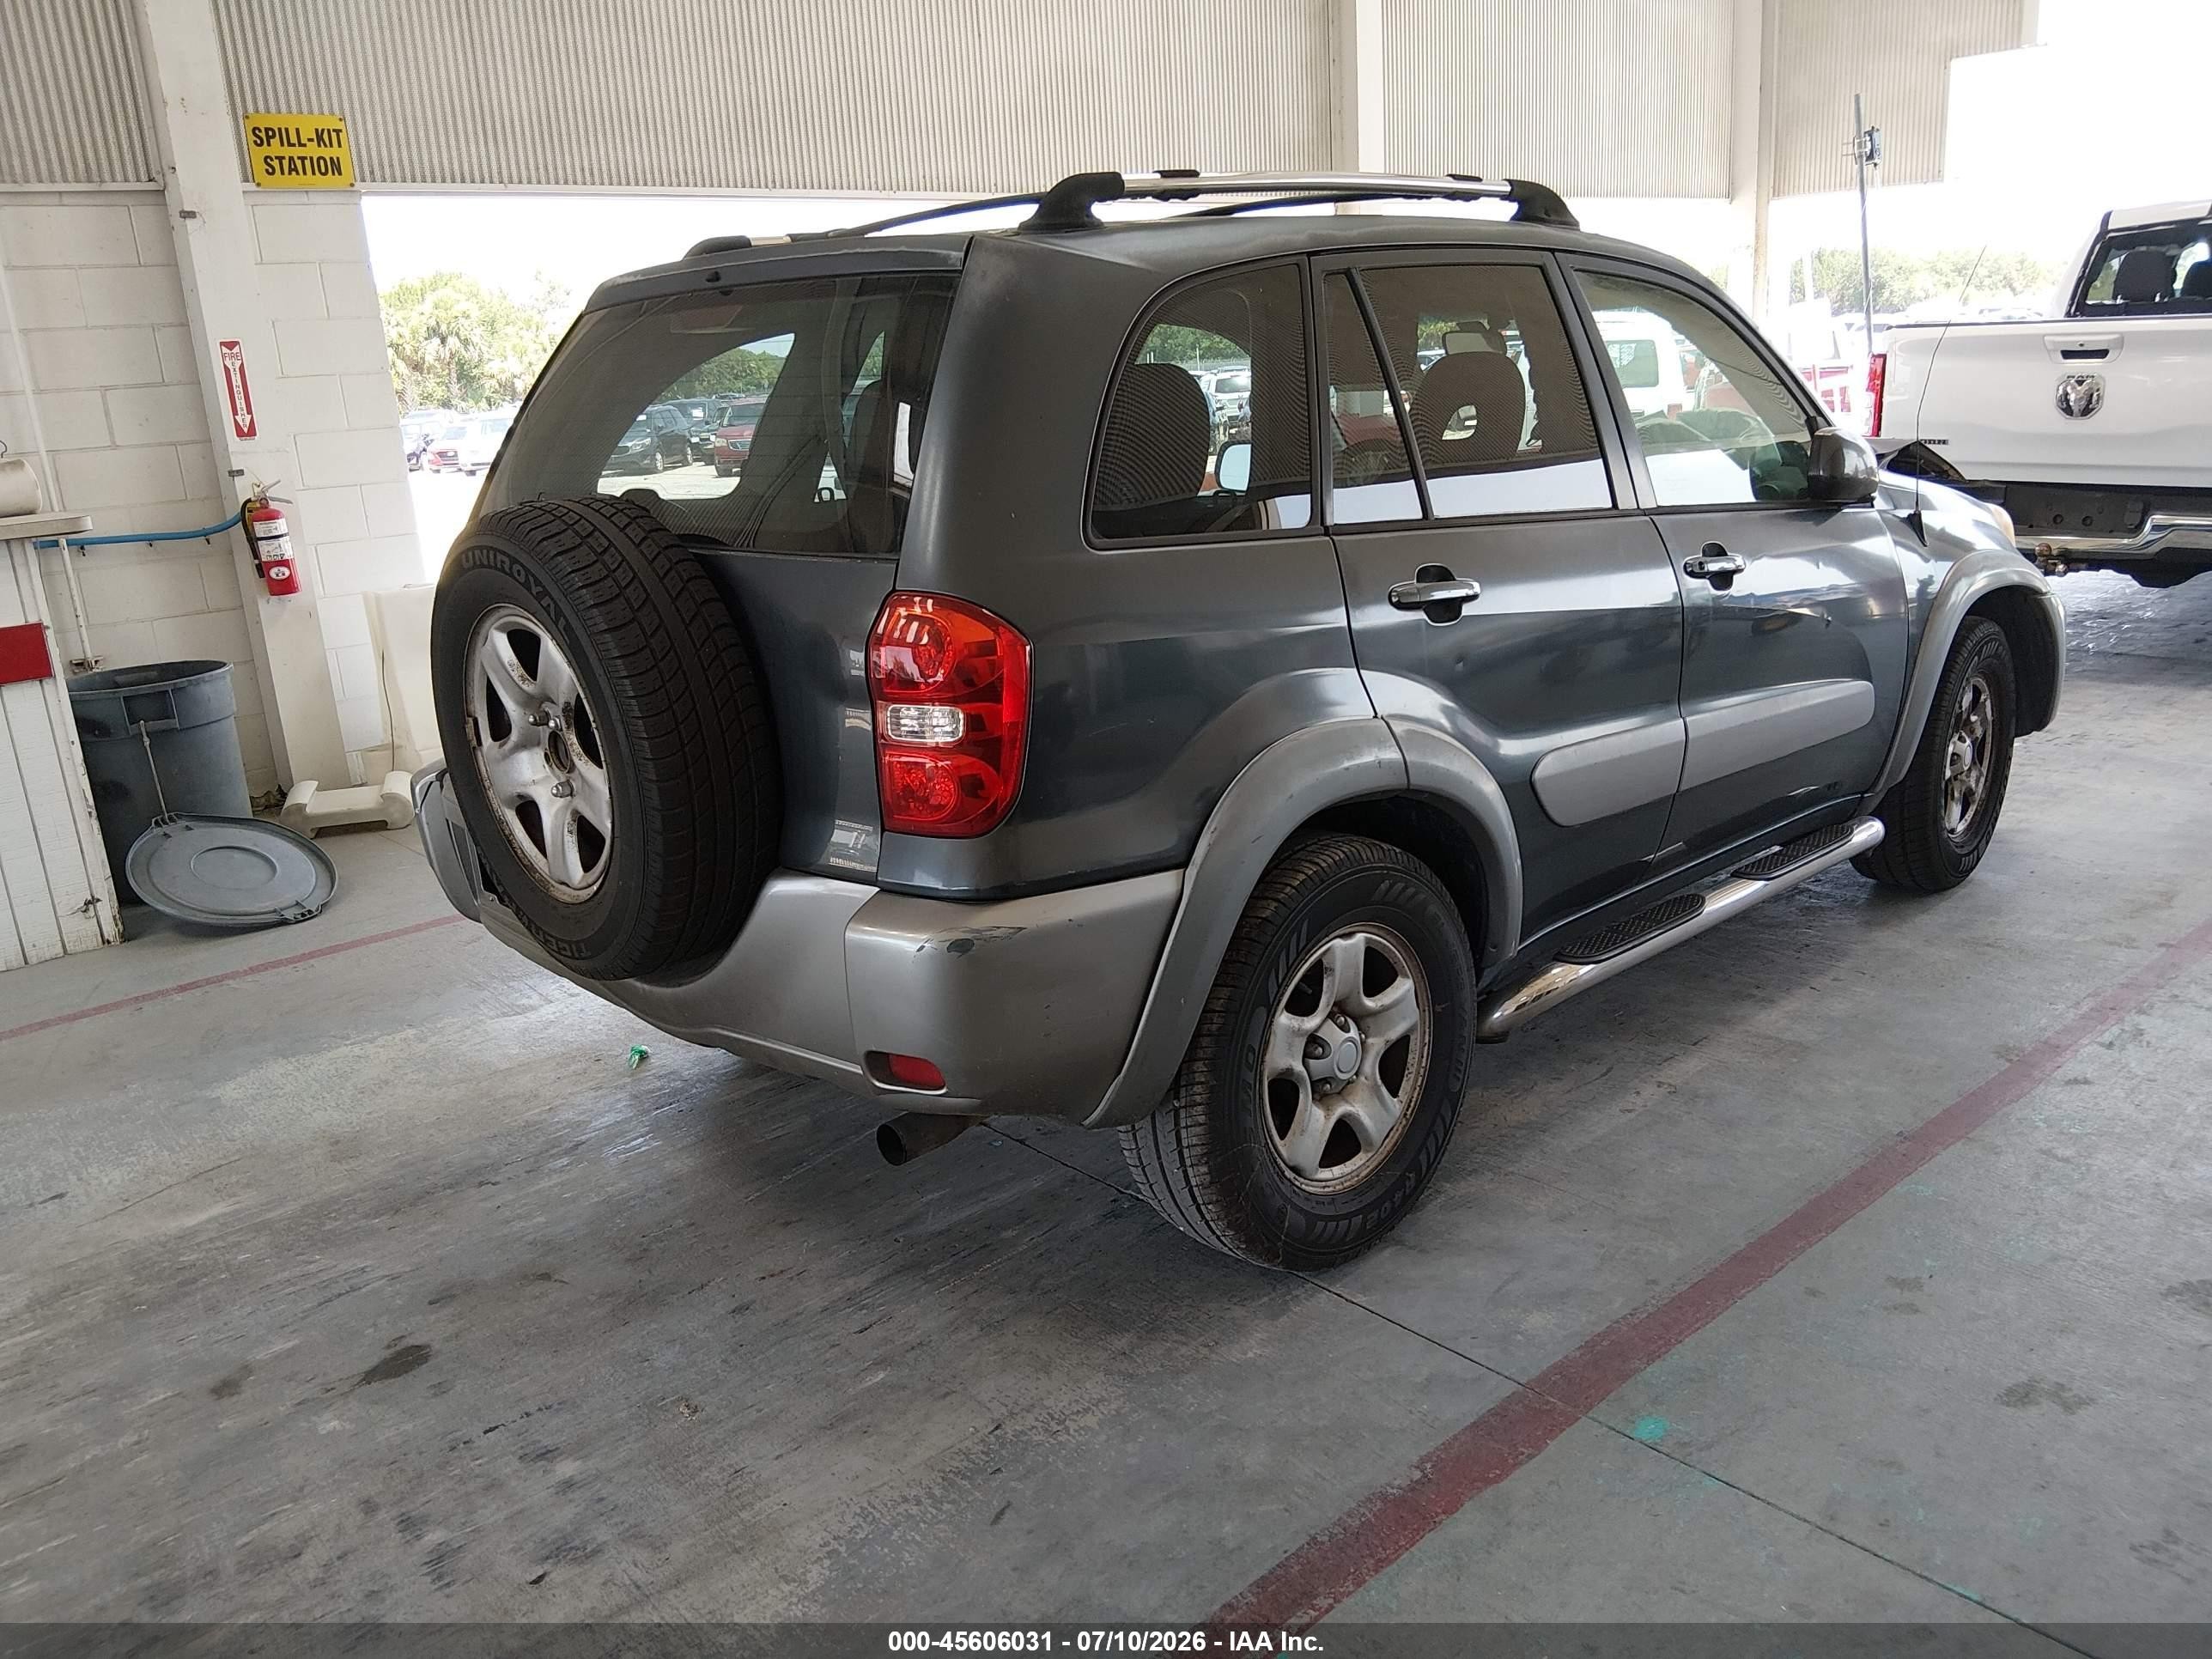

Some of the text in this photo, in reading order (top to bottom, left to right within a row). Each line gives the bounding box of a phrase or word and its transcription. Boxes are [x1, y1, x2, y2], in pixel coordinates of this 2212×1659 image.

[252, 126, 343, 148] SPILL-KIT
[263, 155, 343, 176] STATION
[223, 351, 241, 361] FIRE
[231, 361, 248, 428] EXTINGUISHER
[463, 550, 570, 645] UNIROYAL
